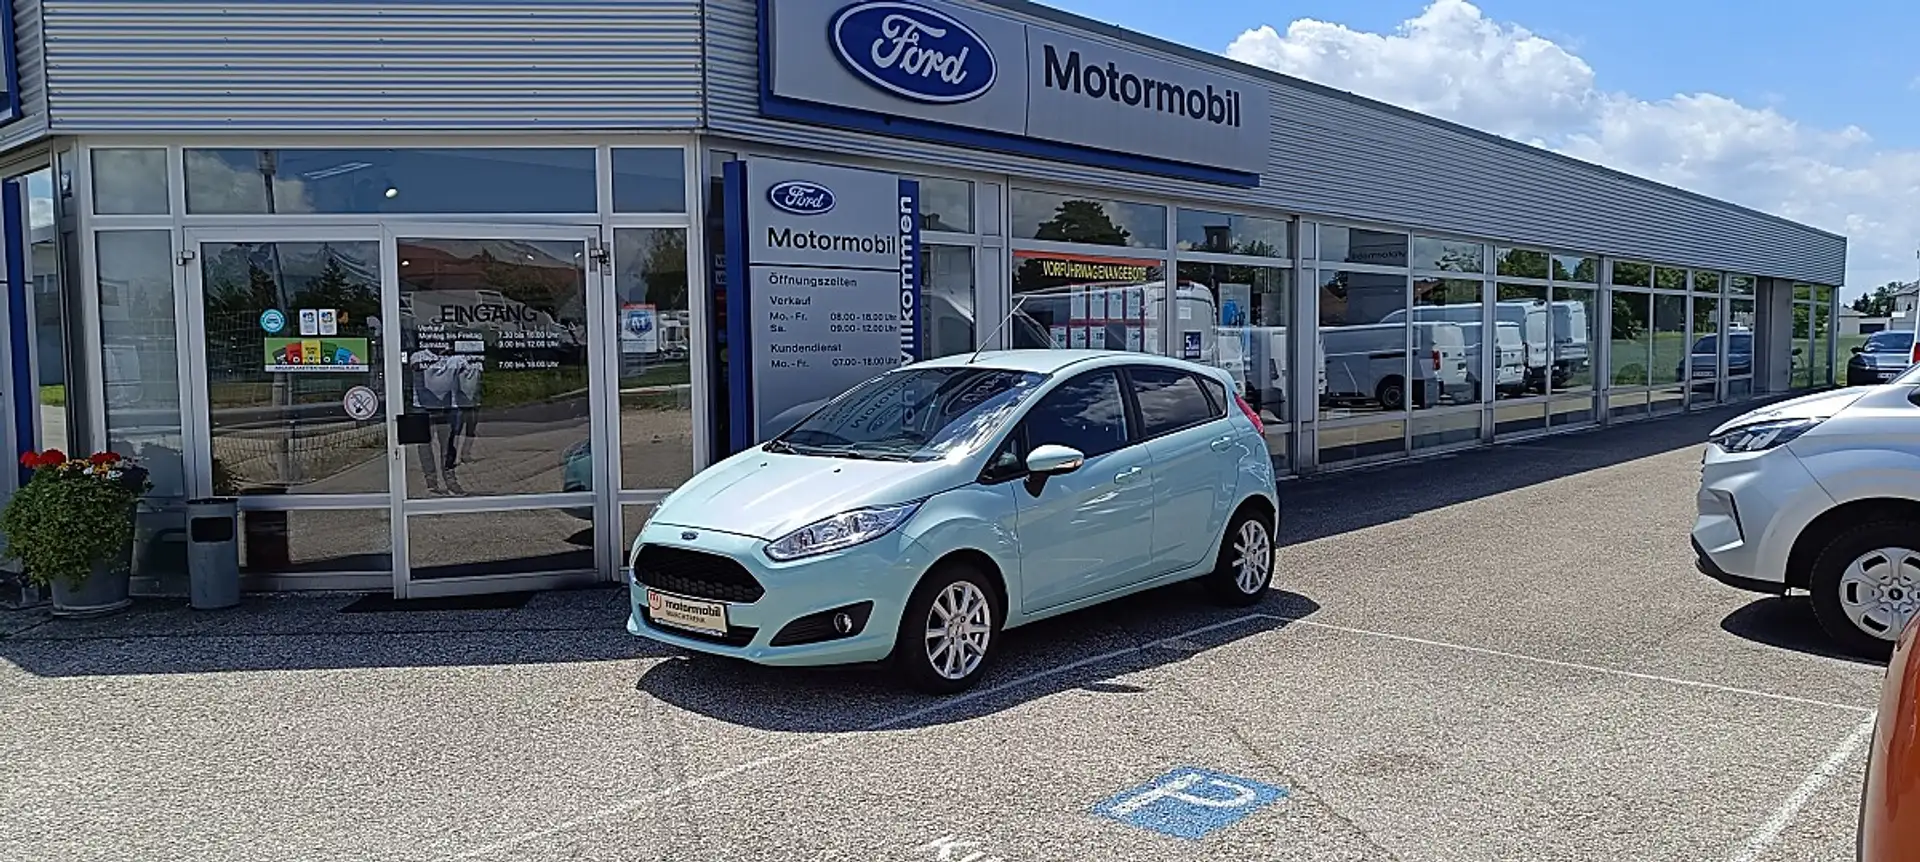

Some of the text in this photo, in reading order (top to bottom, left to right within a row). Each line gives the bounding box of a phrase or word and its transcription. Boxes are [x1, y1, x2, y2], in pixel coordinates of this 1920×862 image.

[871, 14, 969, 85] Ford
[1043, 44, 1240, 127] Motormobil
[785, 185, 823, 208] Ford
[767, 227, 896, 254] Motormobil
[769, 271, 858, 288] Öffnungszeiten
[769, 295, 811, 305] Verkauf
[440, 304, 538, 323] EINGANG
[770, 343, 842, 352] Kundendienst
[664, 599, 721, 617] motormobil
